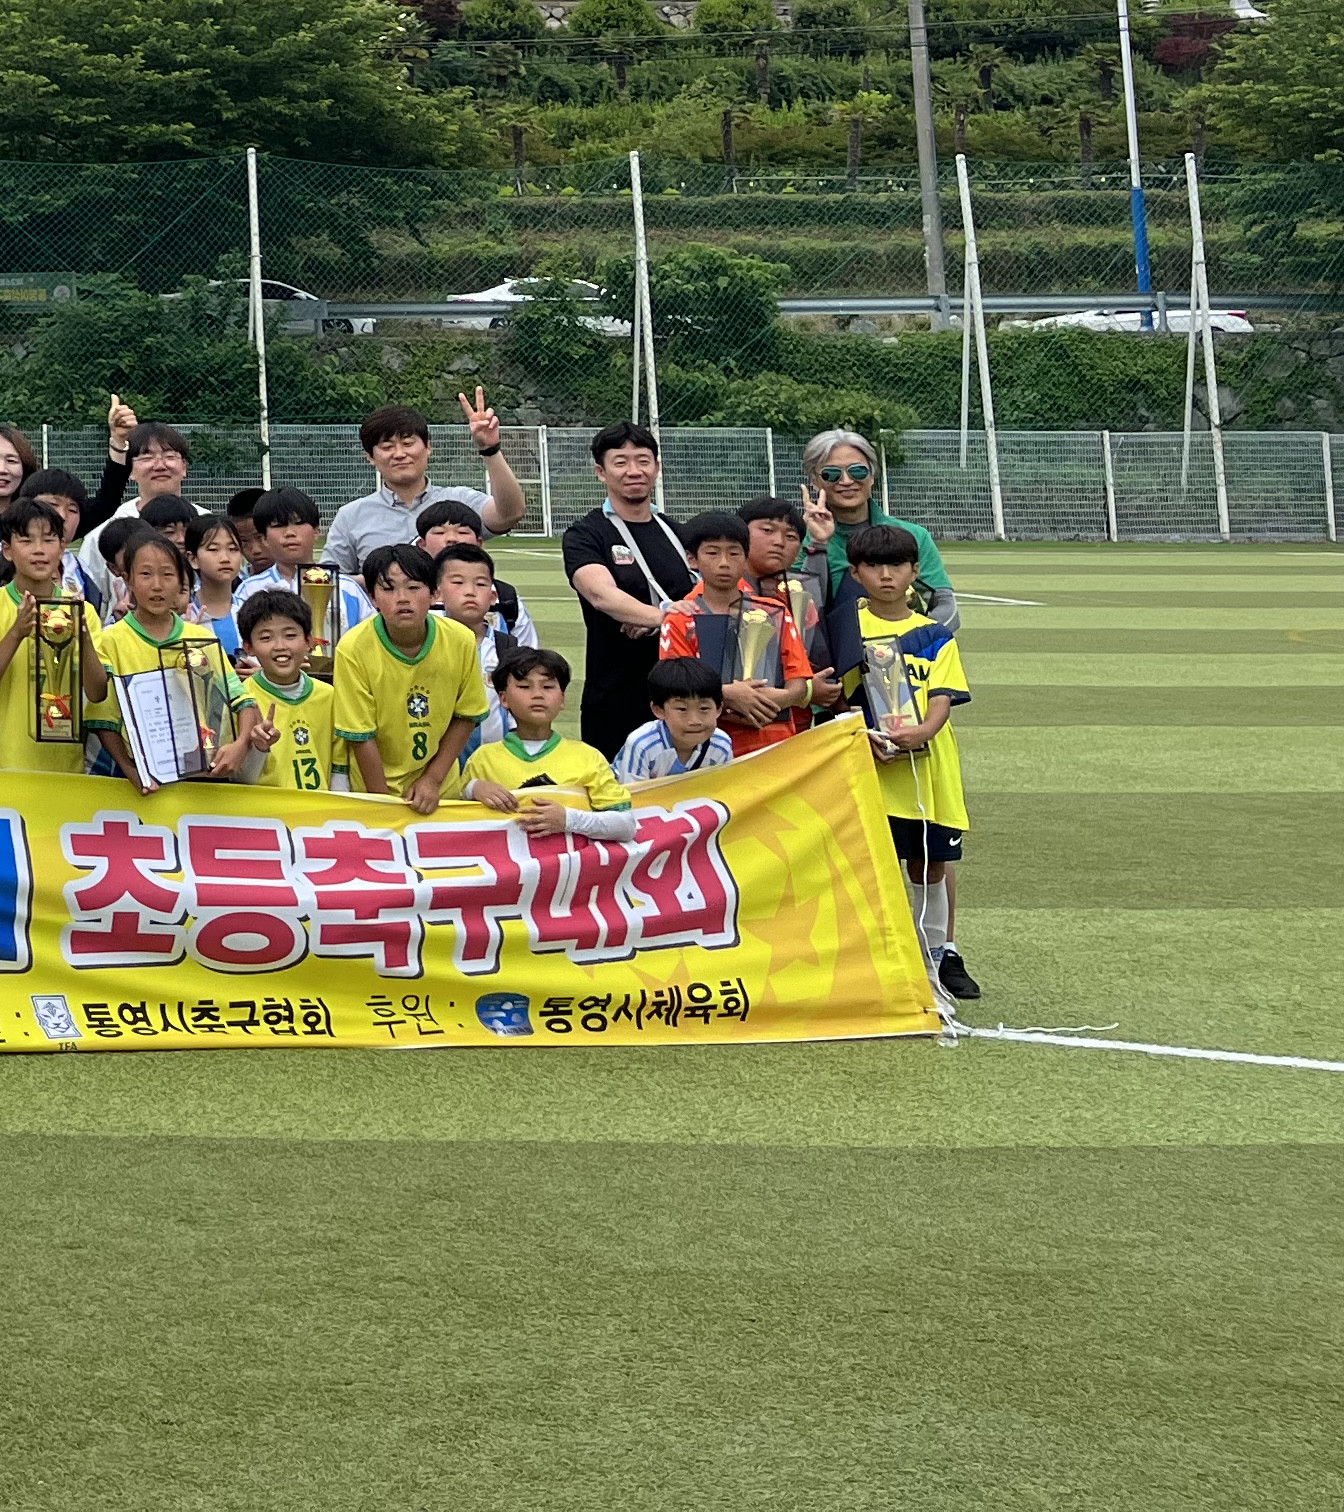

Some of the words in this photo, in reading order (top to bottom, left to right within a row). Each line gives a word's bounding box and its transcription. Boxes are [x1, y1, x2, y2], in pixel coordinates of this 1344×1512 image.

[412, 731, 428, 761] 8
[292, 757, 322, 791] 13
[65, 801, 735, 975] 초등축구대회
[81, 997, 337, 1039] 통영시축구협회
[365, 993, 445, 1039] 후원
[538, 977, 751, 1035] 통영시체육회
